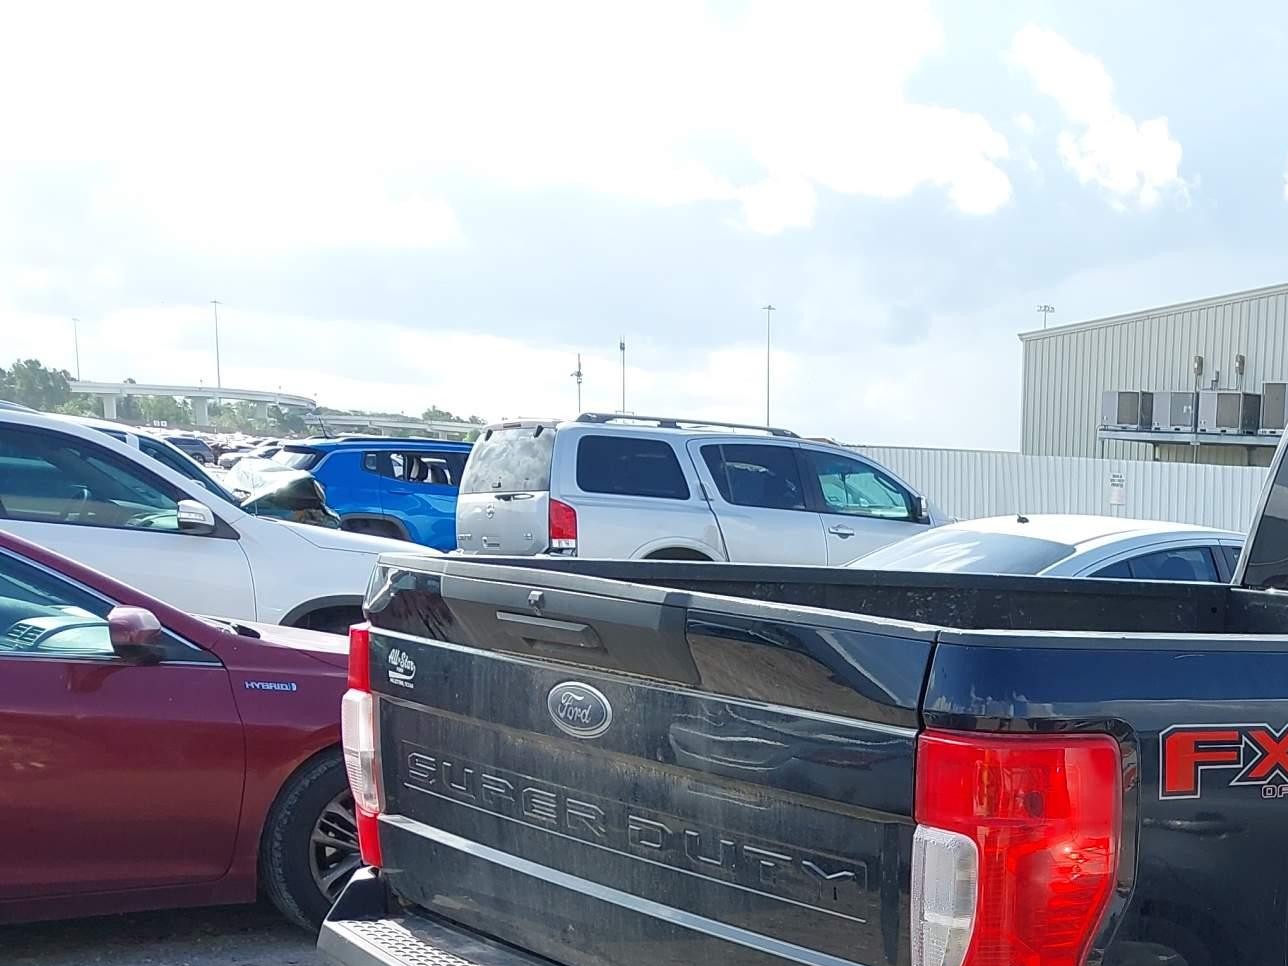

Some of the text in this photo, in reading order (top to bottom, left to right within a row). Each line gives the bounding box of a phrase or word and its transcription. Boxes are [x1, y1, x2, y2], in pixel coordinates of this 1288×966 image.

[244, 681, 291, 691] HYBRID
[558, 691, 592, 724] Ford
[407, 752, 857, 901] SUPER DUTY
